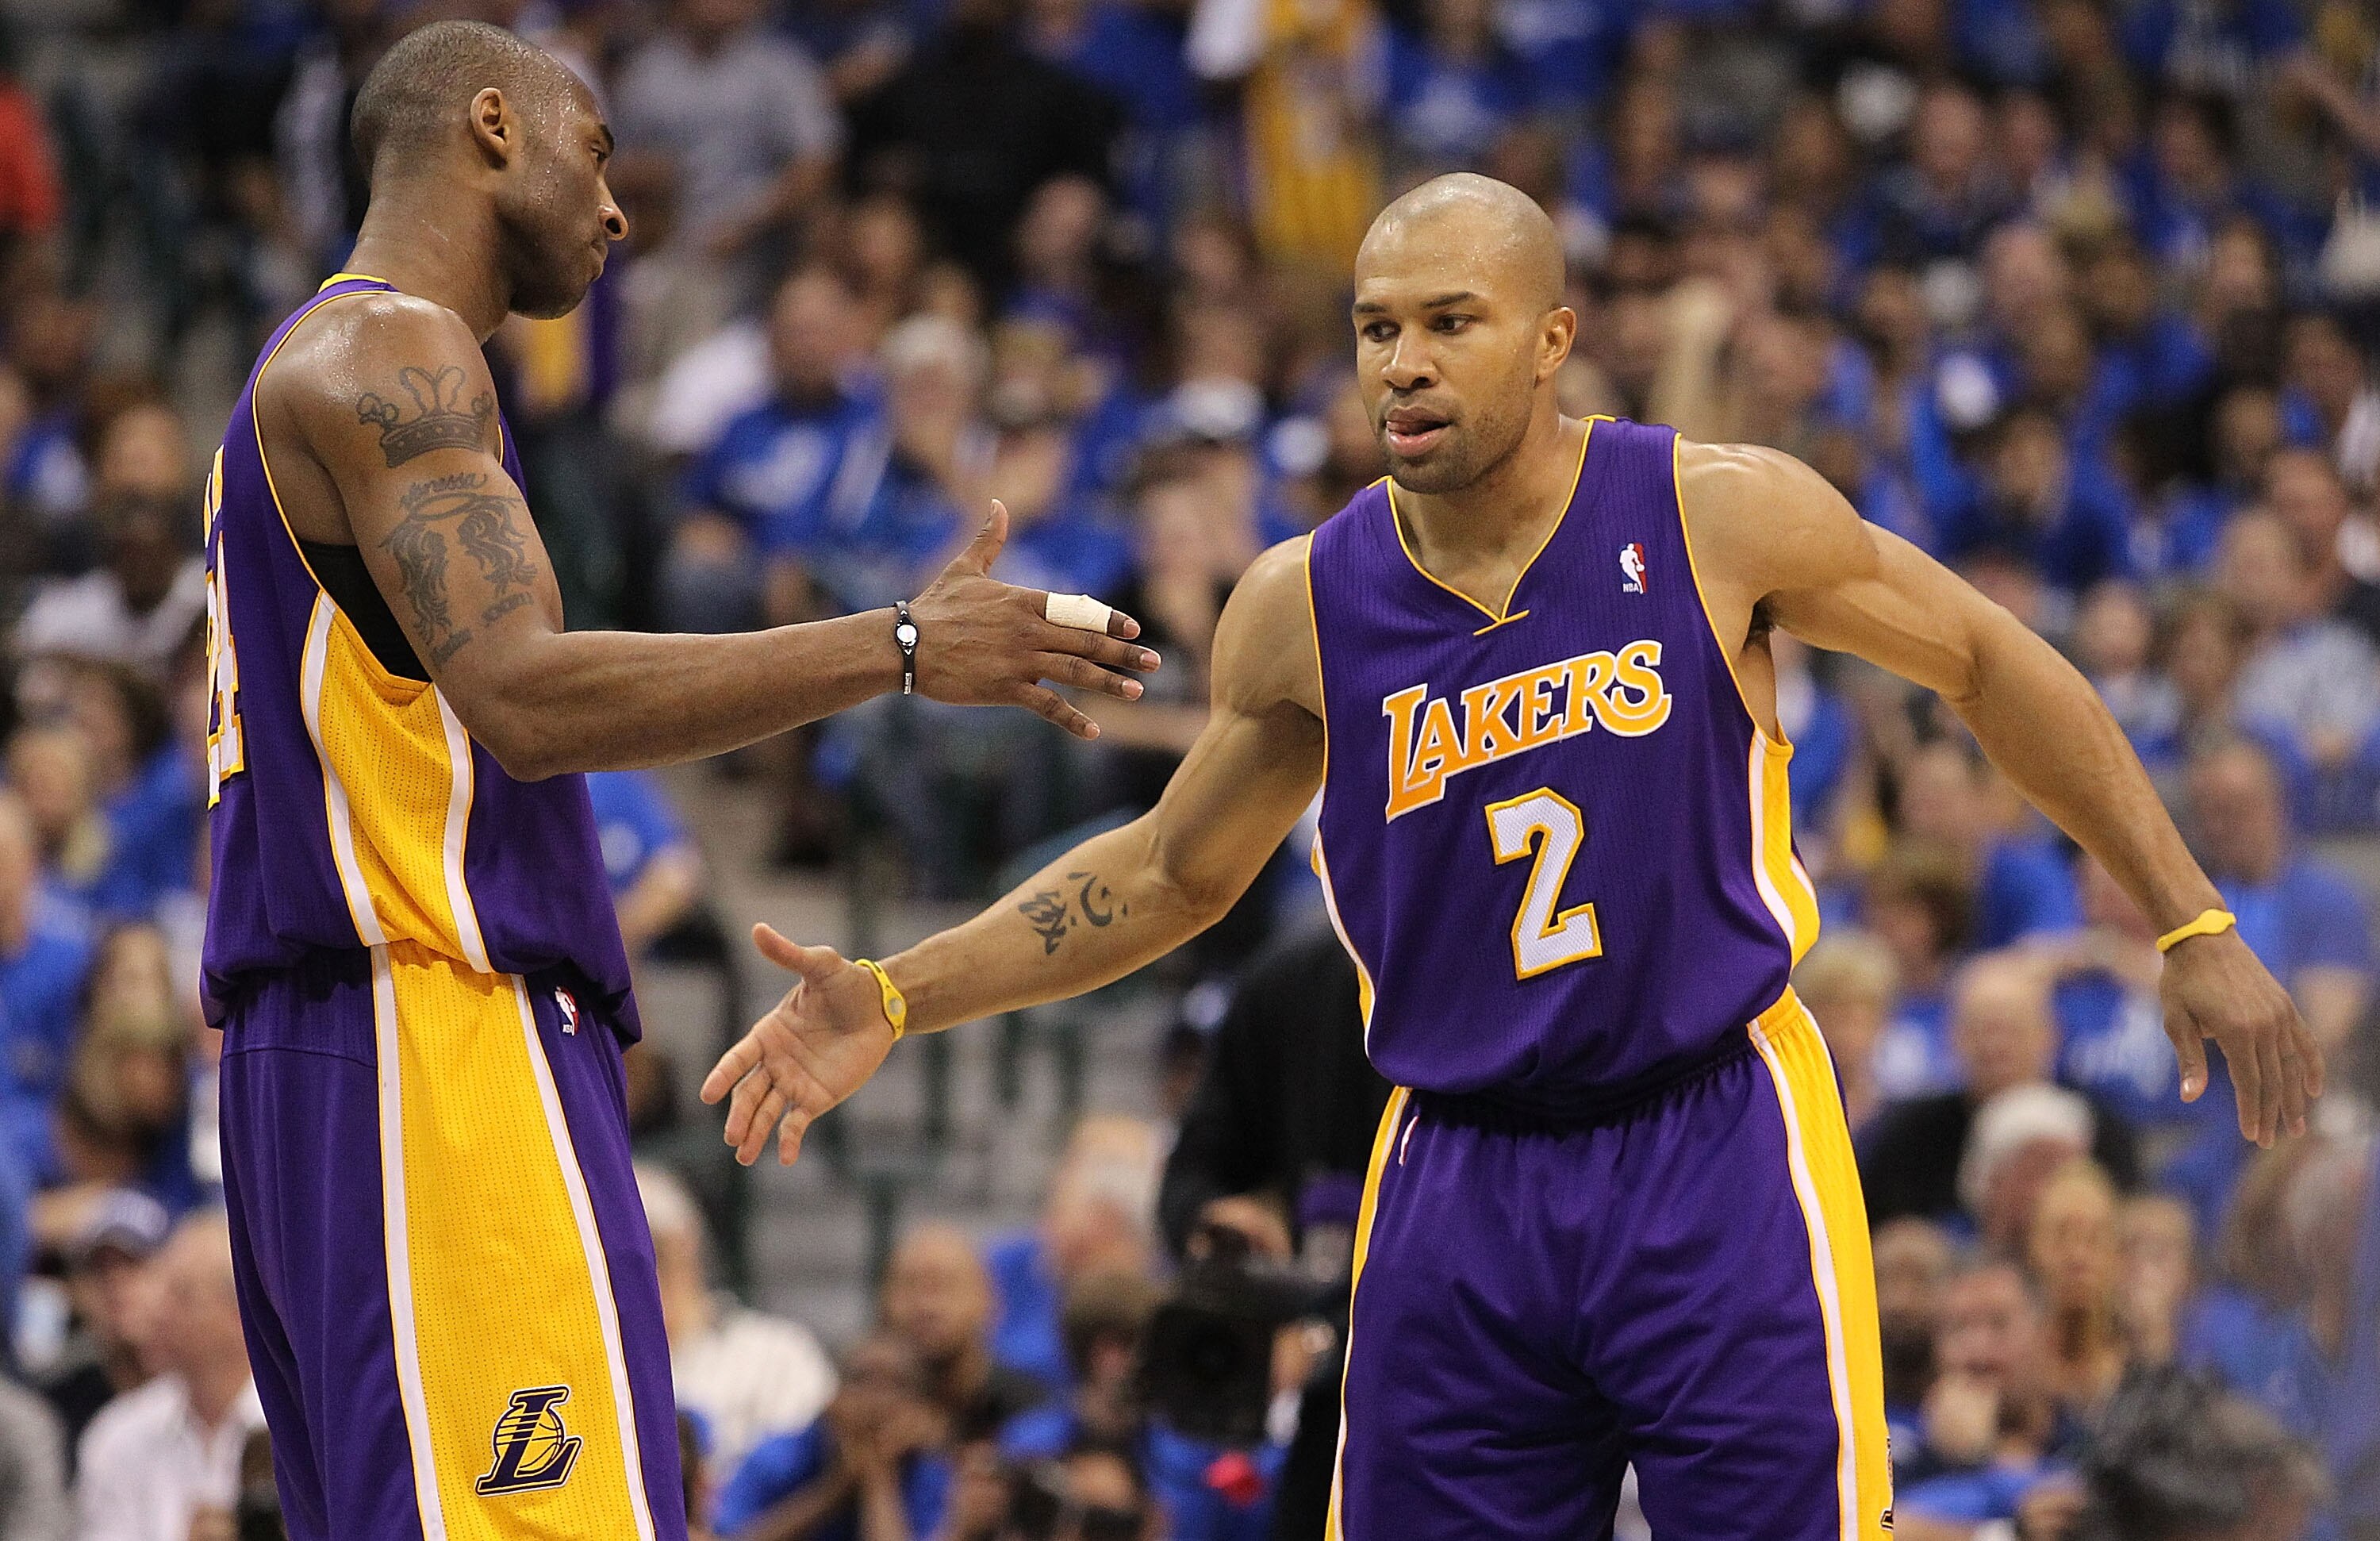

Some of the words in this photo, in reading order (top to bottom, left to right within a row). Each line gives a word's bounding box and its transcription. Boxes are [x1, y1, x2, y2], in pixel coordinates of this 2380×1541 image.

[1622, 582, 1640, 594] NBA
[1382, 640, 1672, 824] LAKERS
[1484, 786, 1603, 982] 2
